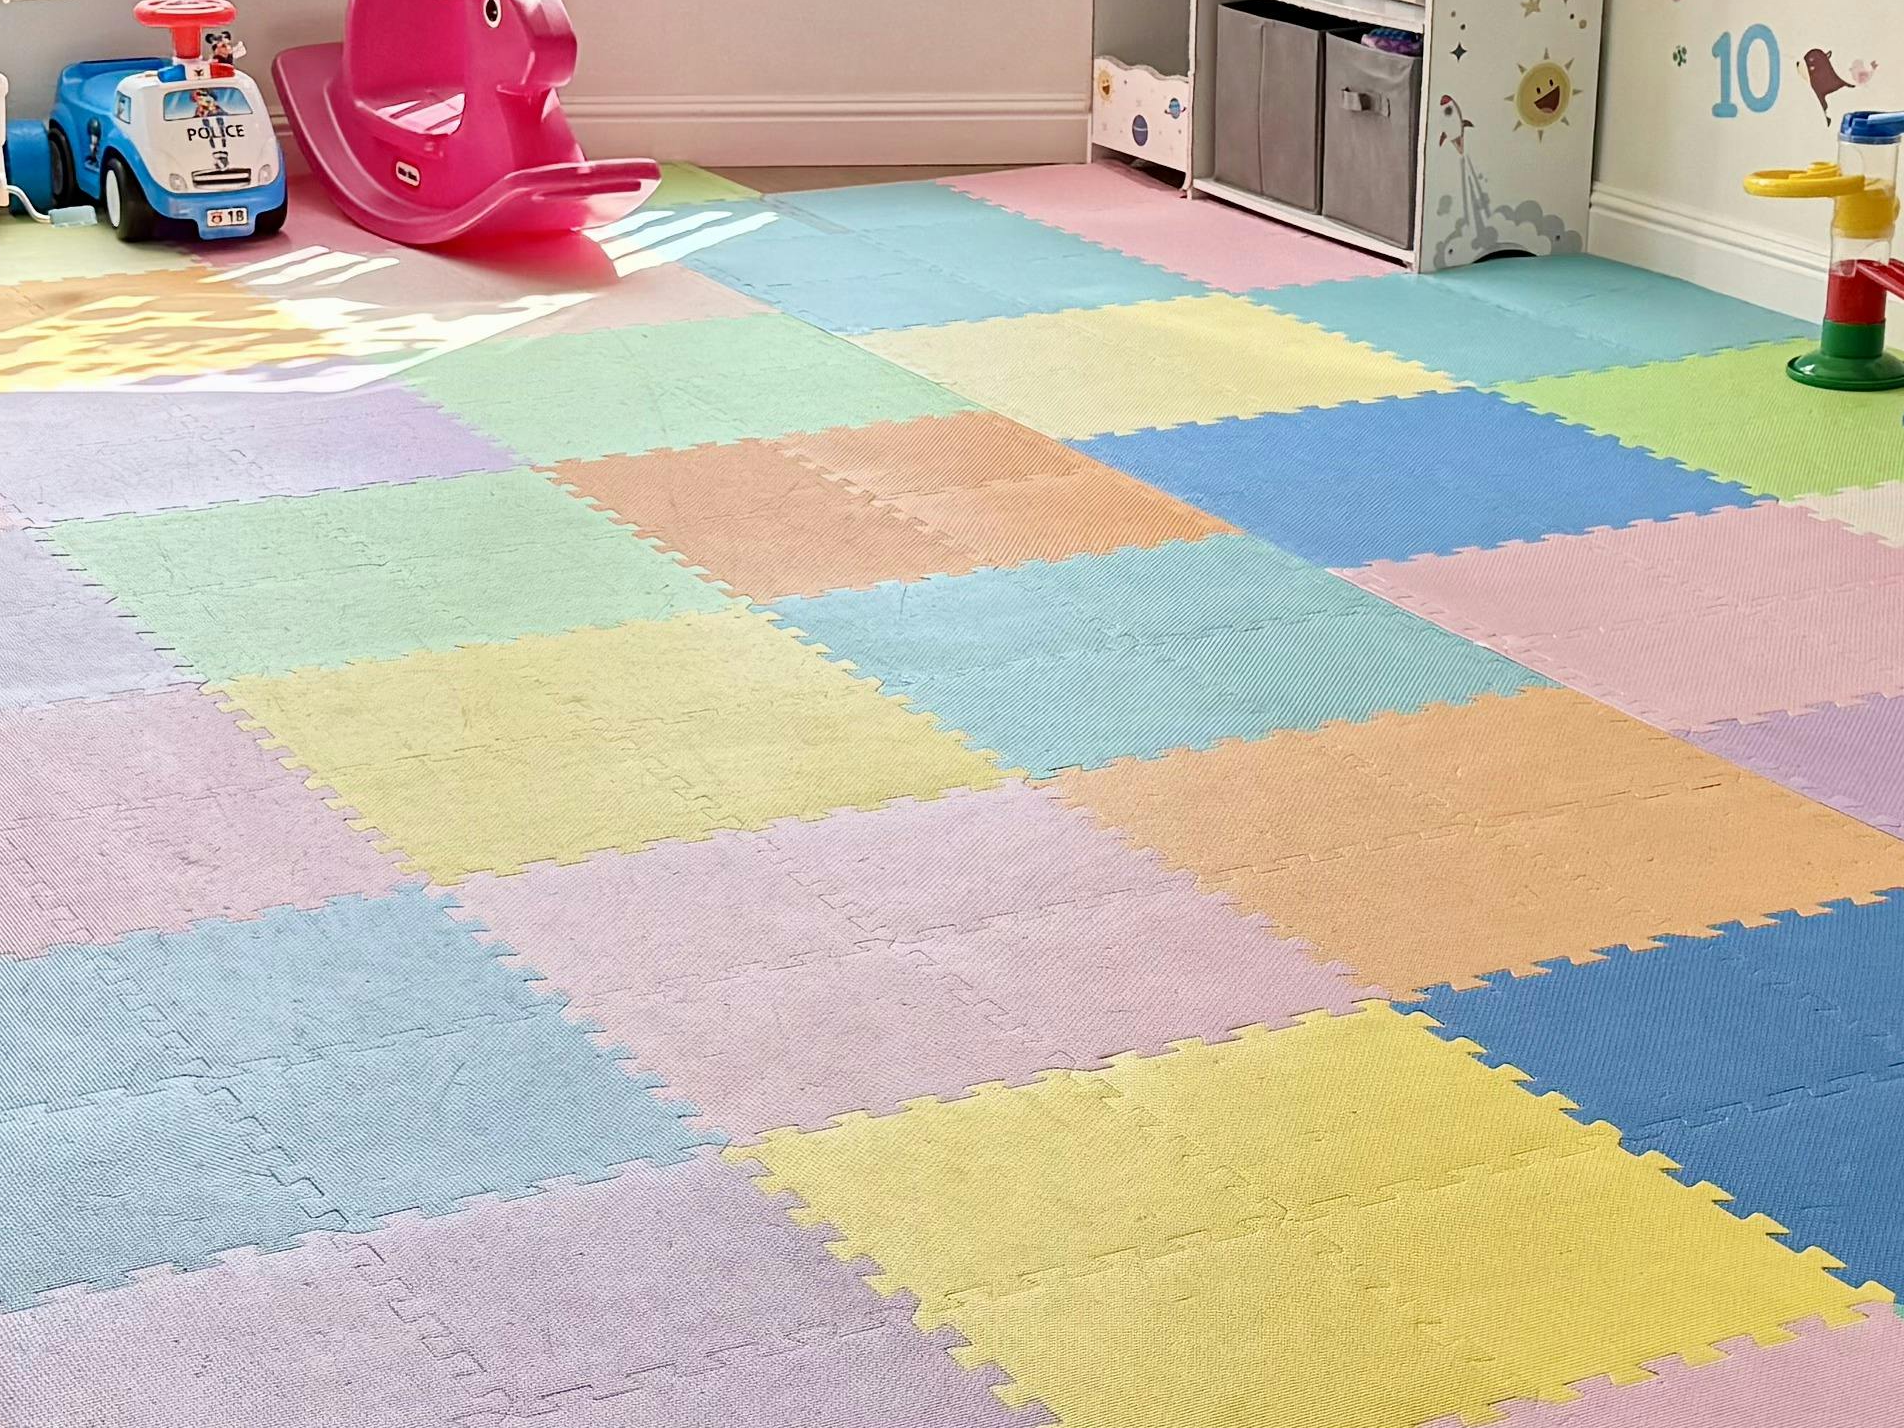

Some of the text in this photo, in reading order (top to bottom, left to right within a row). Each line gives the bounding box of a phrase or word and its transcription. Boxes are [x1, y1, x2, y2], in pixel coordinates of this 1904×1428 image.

[1710, 23, 1780, 117] 10
[187, 125, 245, 141] POLICE
[228, 210, 244, 223] 18
